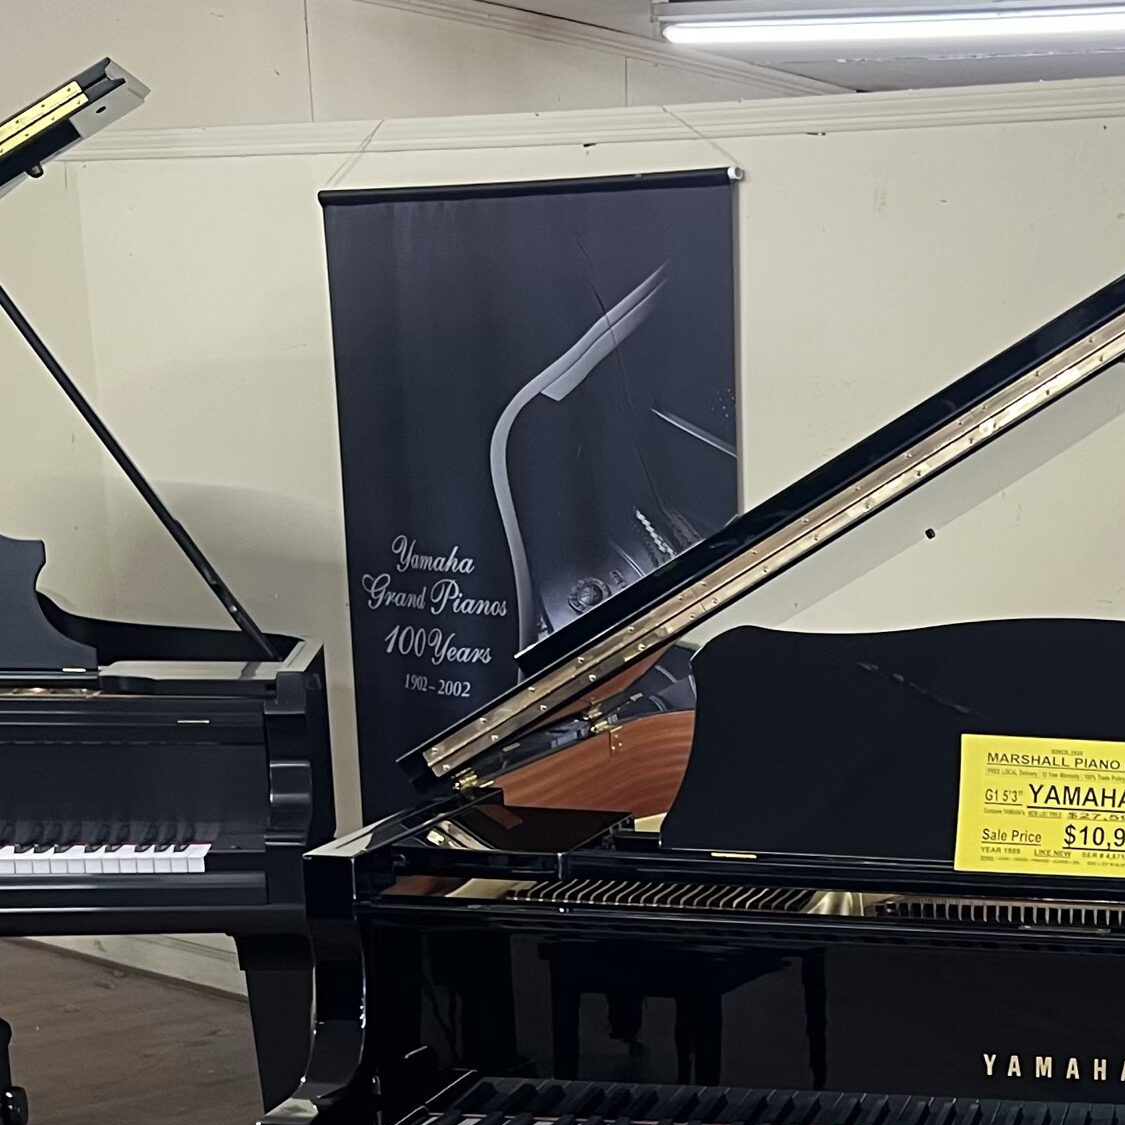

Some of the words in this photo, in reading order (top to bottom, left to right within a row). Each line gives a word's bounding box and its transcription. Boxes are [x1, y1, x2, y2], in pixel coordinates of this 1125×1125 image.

[391, 535, 475, 574] Yamaha
[362, 573, 426, 610] Grand
[430, 578, 508, 616] Pianos
[987, 752, 1069, 767] MARSHALL
[1074, 757, 1121, 770] PIANO
[984, 788, 999, 801] G1
[982, 828, 1007, 841] Sale
[1011, 829, 1042, 843] Price
[981, 846, 1001, 854] YEAR
[1034, 849, 1051, 857] LIKE
[1054, 850, 1072, 858] NEW
